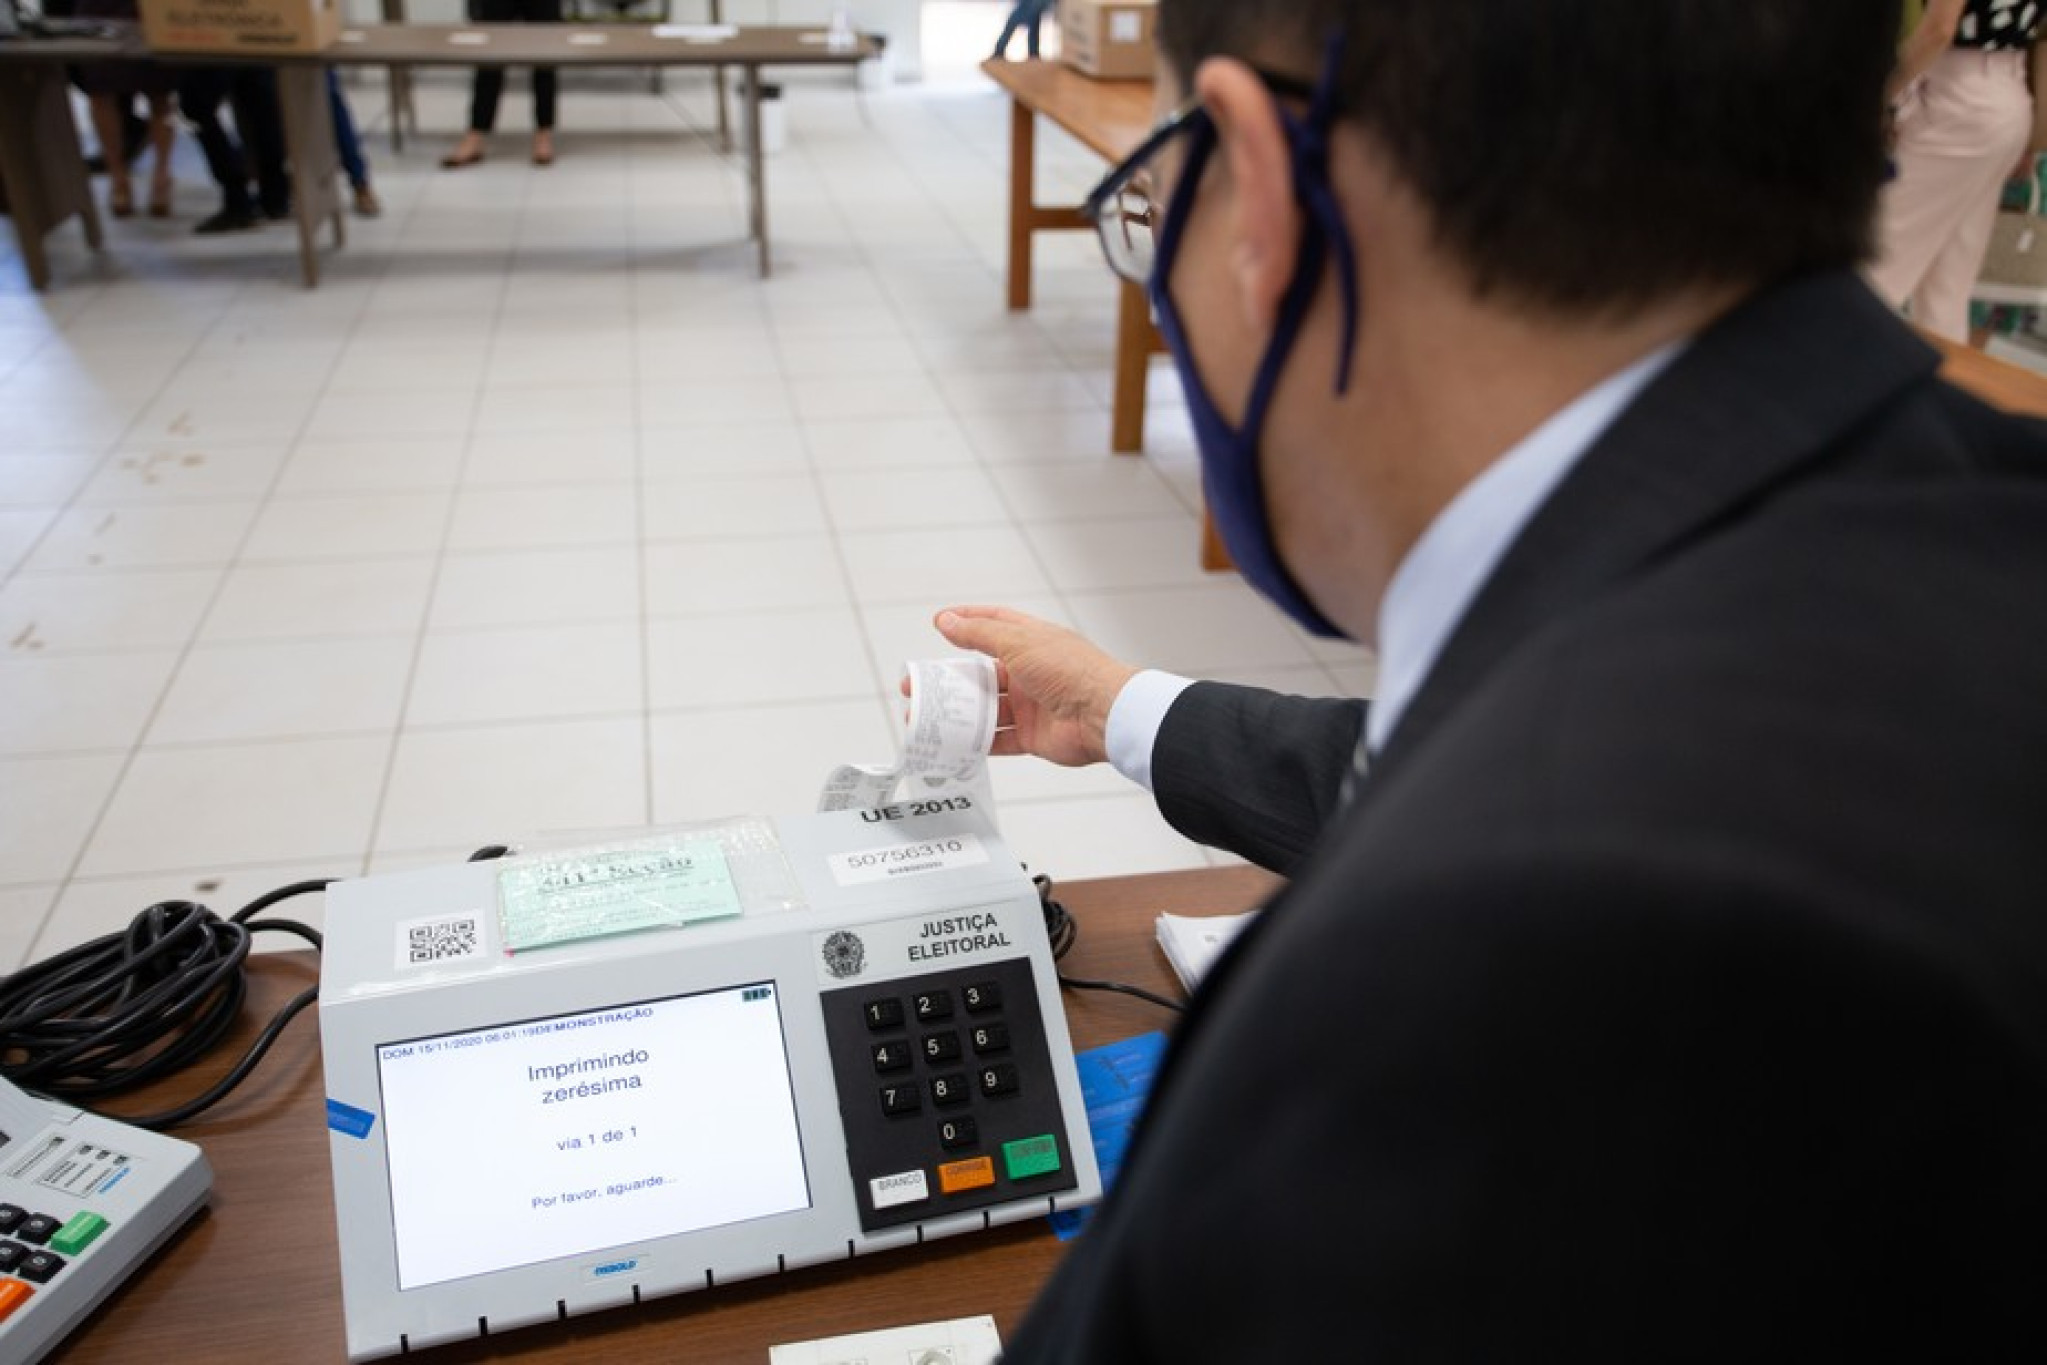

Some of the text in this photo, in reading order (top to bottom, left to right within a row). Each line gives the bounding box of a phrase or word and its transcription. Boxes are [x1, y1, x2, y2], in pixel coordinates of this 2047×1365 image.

[861, 796, 972, 822] UE 2013
[847, 838, 963, 869] 50756310
[919, 912, 998, 937] JUSTIÇA
[907, 932, 1011, 962] ELEITORAL
[967, 987, 980, 1004] 3
[870, 1004, 880, 1020] 1
[918, 996, 931, 1013] 2
[976, 1029, 988, 1046] 6
[382, 1046, 414, 1060] DOM
[927, 1038, 940, 1055] 5
[528, 1048, 649, 1081] Imprimindo
[876, 1047, 888, 1065] 4
[985, 1071, 997, 1088] 9
[542, 1074, 642, 1104] zerésima
[936, 1080, 947, 1097] 8
[885, 1089, 896, 1106] 7
[556, 1125, 637, 1151] via 1 de 1
[943, 1123, 955, 1140] 0
[877, 1172, 923, 1191] BRANCO
[531, 1196, 557, 1209] Por
